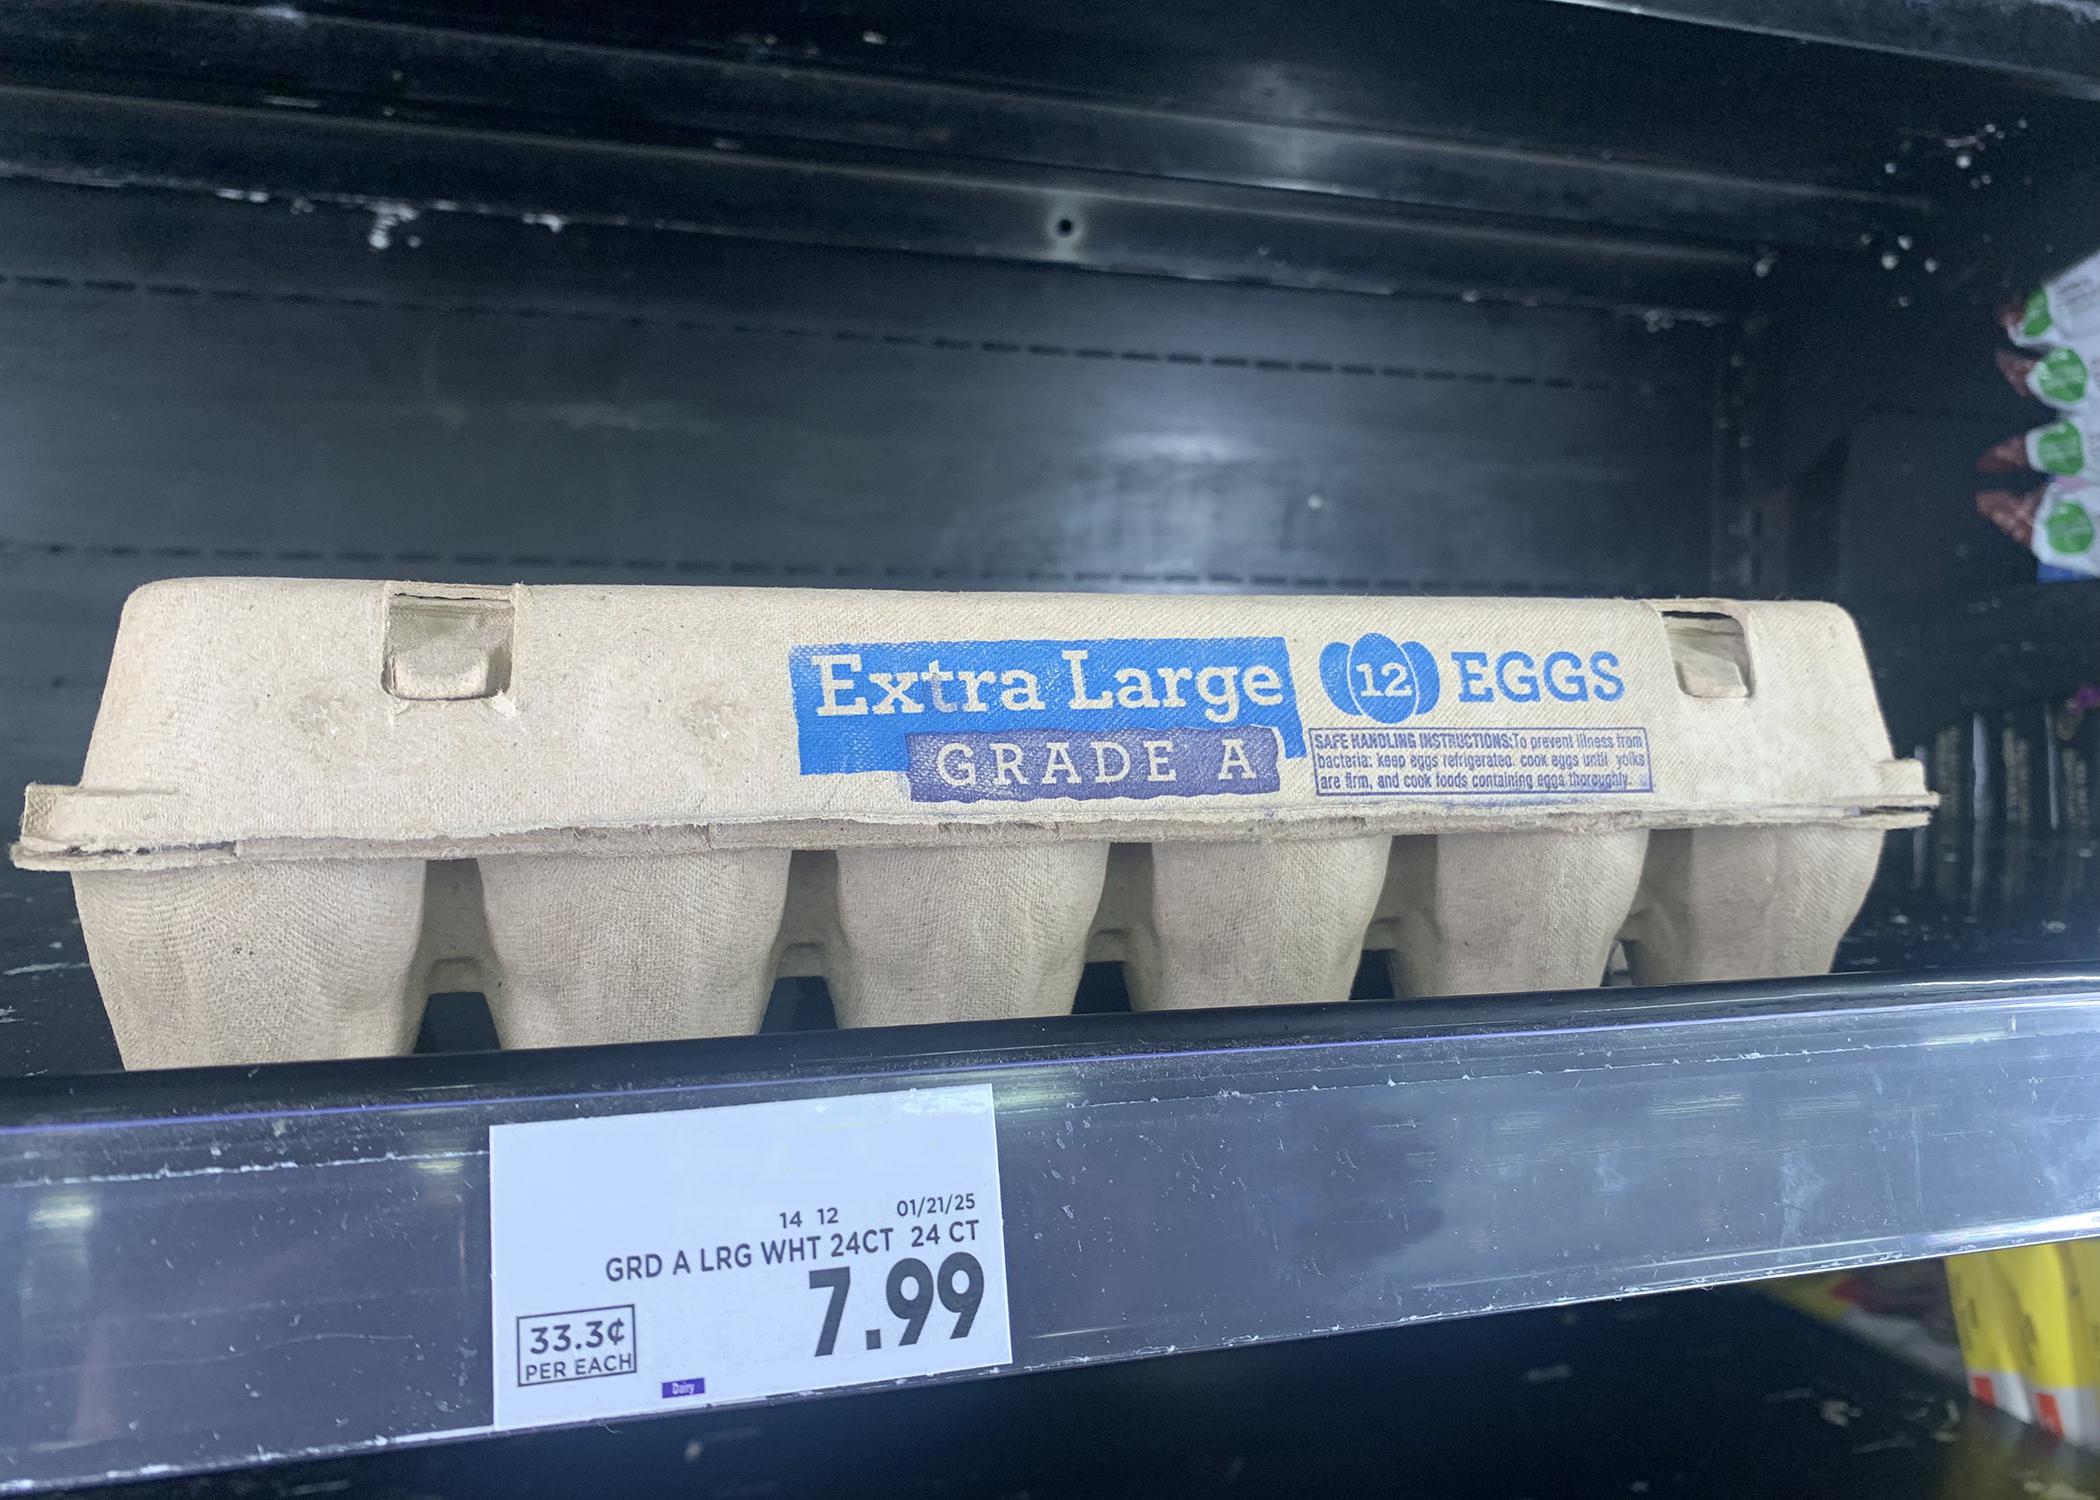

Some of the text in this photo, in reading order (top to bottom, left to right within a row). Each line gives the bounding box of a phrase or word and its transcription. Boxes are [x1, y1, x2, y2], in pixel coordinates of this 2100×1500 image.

[811, 650, 1284, 723] Extra Large
[1356, 651, 1626, 703] 12 EGGS
[1314, 733, 1644, 751] SAFE HANDLING INSTRUCTIONS: To prevent illness from
[937, 737, 1258, 787] GRADE A
[1317, 753, 1373, 769] bacteria:
[1376, 752, 1406, 770] keep
[1410, 756, 1439, 771] eggs
[1520, 753, 1547, 768] cook
[1551, 755, 1579, 770] eggs
[1583, 753, 1608, 767] until
[1615, 752, 1645, 769] yolks
[1320, 772, 1632, 791] are firm, and cook foods containing eggs thoroughly.
[779, 1193, 976, 1229] 14 12 01/21/25
[606, 1219, 980, 1282] GRD A LRG WHT 24CT 24 CT
[808, 1251, 985, 1358] 7.99
[529, 1317, 626, 1355] 33.3¢
[525, 1353, 632, 1381] PER EACH
[671, 1380, 696, 1396] Dairy
